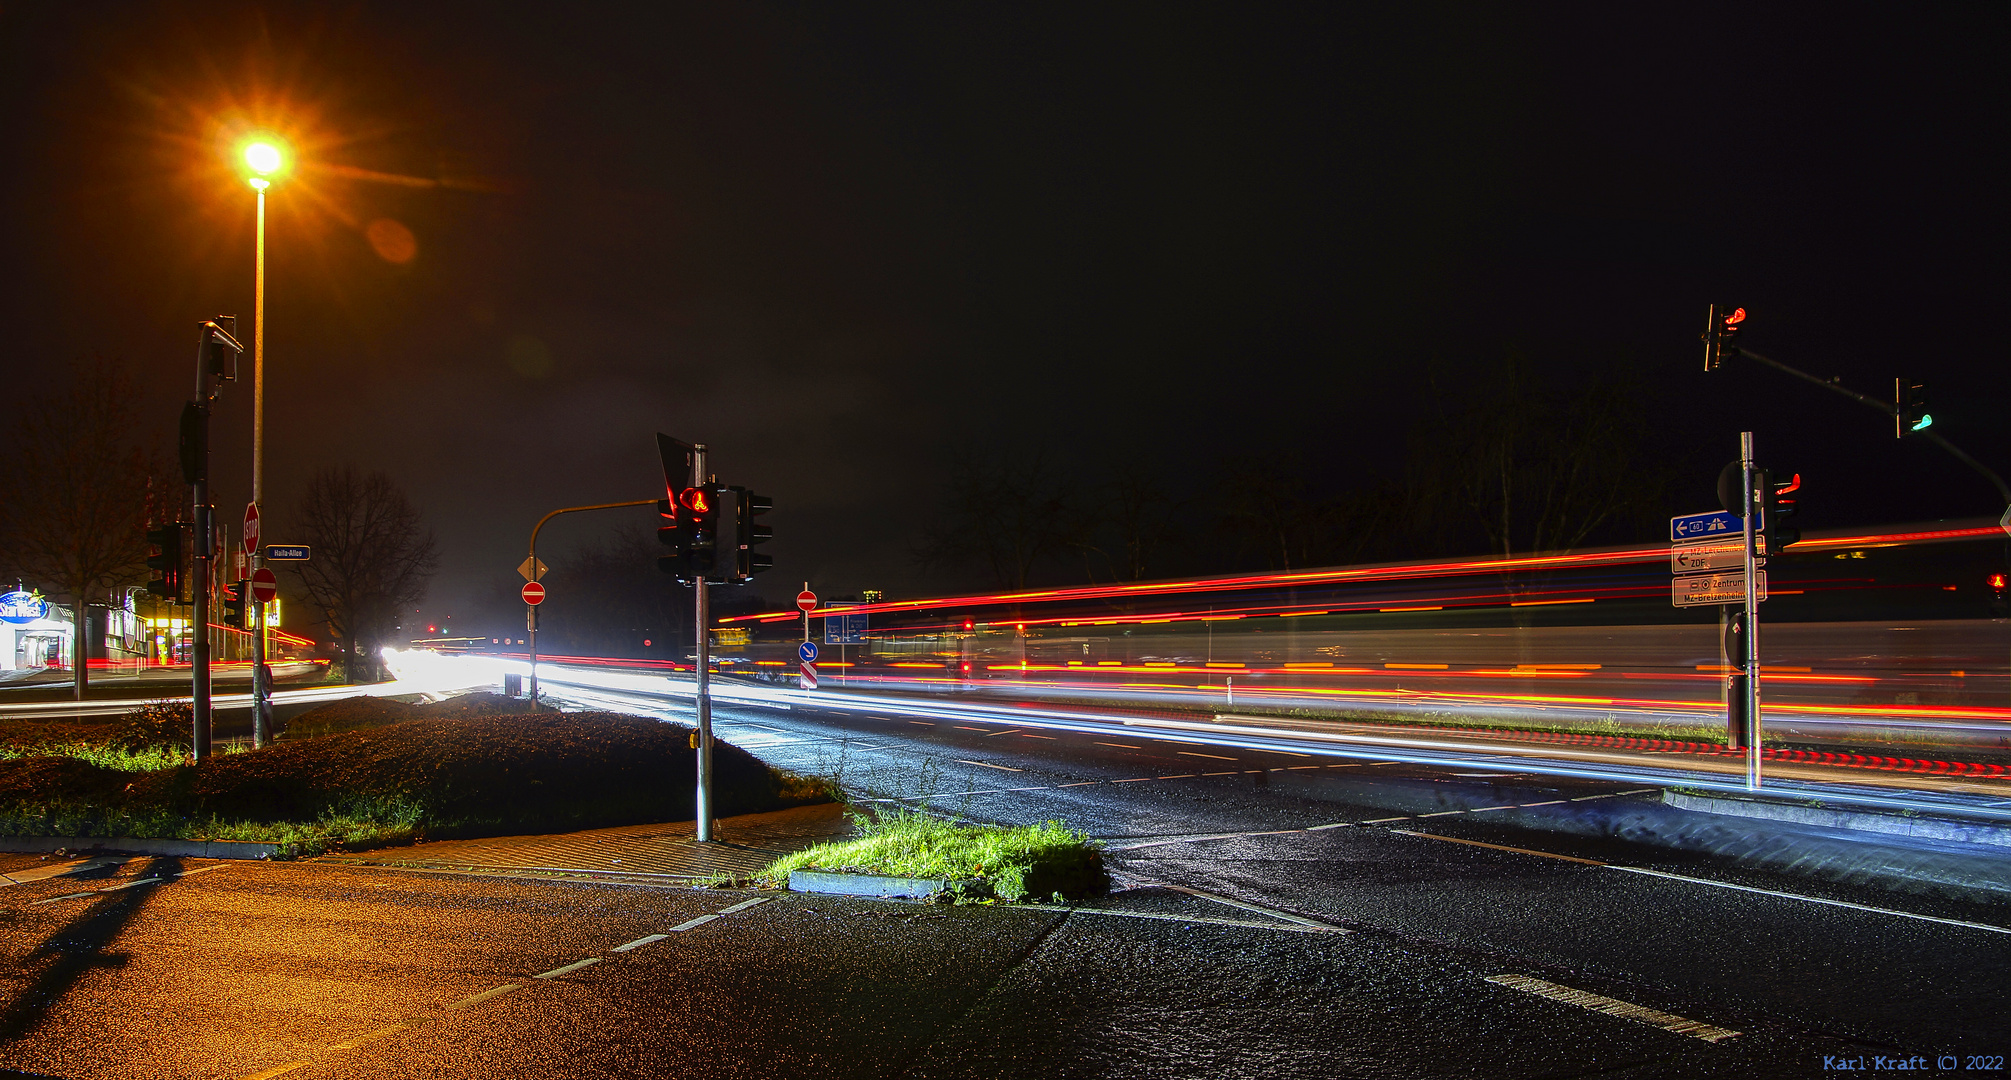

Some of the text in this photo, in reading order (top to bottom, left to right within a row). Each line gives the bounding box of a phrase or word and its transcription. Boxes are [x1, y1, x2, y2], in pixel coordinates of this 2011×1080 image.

[245, 518, 258, 536] STOP
[1691, 558, 1706, 568] ZDF
[1713, 579, 1745, 588] Zentrum
[1684, 590, 1746, 603] MZ-Bretzenheim
